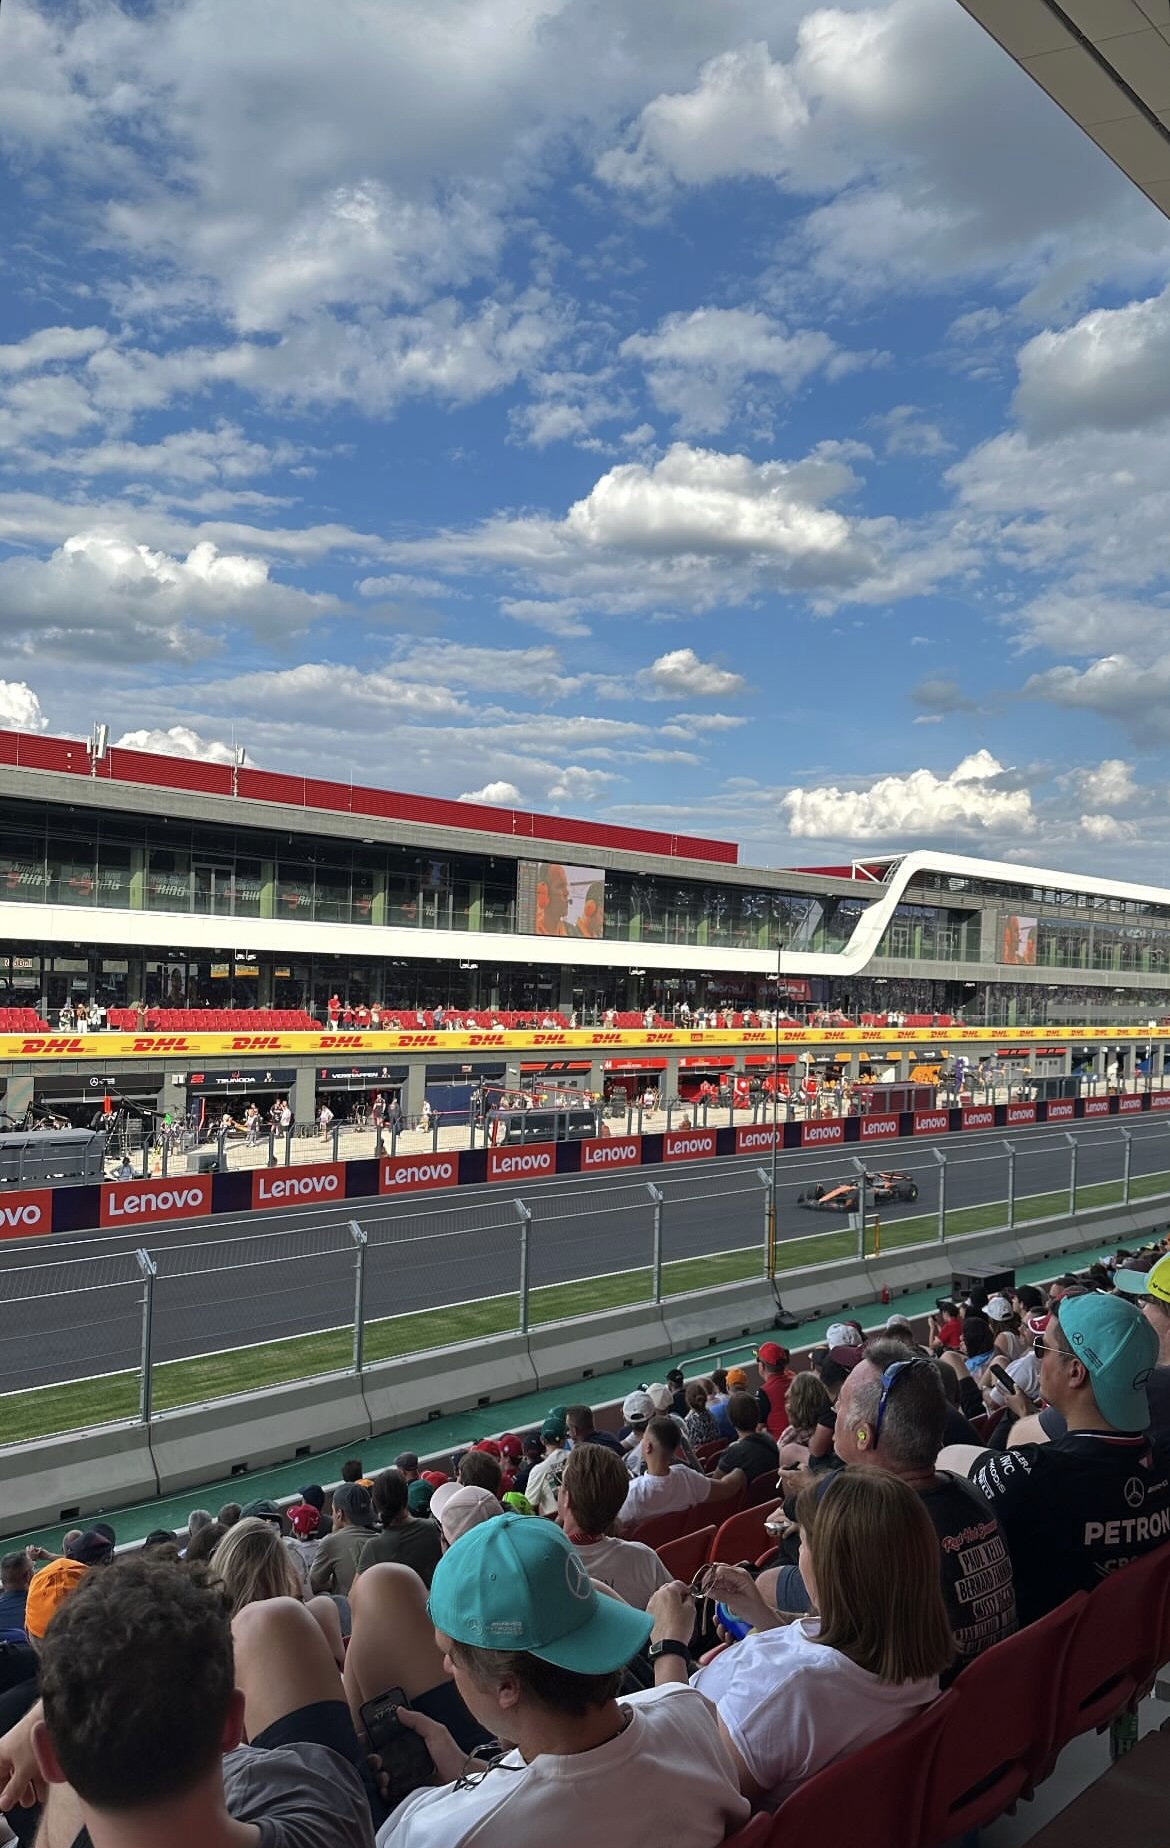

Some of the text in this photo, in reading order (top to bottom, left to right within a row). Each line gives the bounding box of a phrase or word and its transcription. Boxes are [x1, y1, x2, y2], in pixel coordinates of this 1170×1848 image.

[397, 1035, 438, 1047] DHL
[468, 1034, 505, 1046] DHL
[532, 1033, 568, 1044] DHL
[591, 1033, 622, 1044] DHL
[645, 1033, 674, 1043] DHL
[742, 1032, 766, 1041] DHL
[783, 1031, 806, 1040] DHL
[823, 1031, 845, 1040] DHL
[862, 1031, 881, 1039] DHL
[897, 1031, 915, 1039] DHL
[962, 1030, 978, 1038] DHL
[21, 1039, 85, 1053] DHL
[133, 1038, 189, 1051] DHL
[231, 1037, 281, 1050] DHL
[320, 1036, 364, 1048] DHL
[1048, 1103, 1073, 1117] Lenovo
[1086, 1100, 1108, 1113] Lenovo
[1119, 1098, 1141, 1109] Lenovo
[964, 1111, 993, 1125] Lenovo
[1008, 1107, 1035, 1121] Lenovo
[862, 1121, 896, 1135] Lenovo
[915, 1115, 947, 1130] Lenovo
[739, 1130, 780, 1147] Lenovo
[804, 1125, 841, 1141] Lenovo
[667, 1137, 712, 1155] Lenovo
[585, 1144, 637, 1164] Lenovo
[492, 1153, 550, 1174] Lenovo
[385, 1163, 452, 1186] Lenovo
[259, 1174, 338, 1199] Lenovo
[109, 1188, 203, 1216] Lenovo
[1000, 1454, 1016, 1476] IWC
[961, 1549, 985, 1573] PAUL
[959, 1568, 993, 1600] BERNARD
